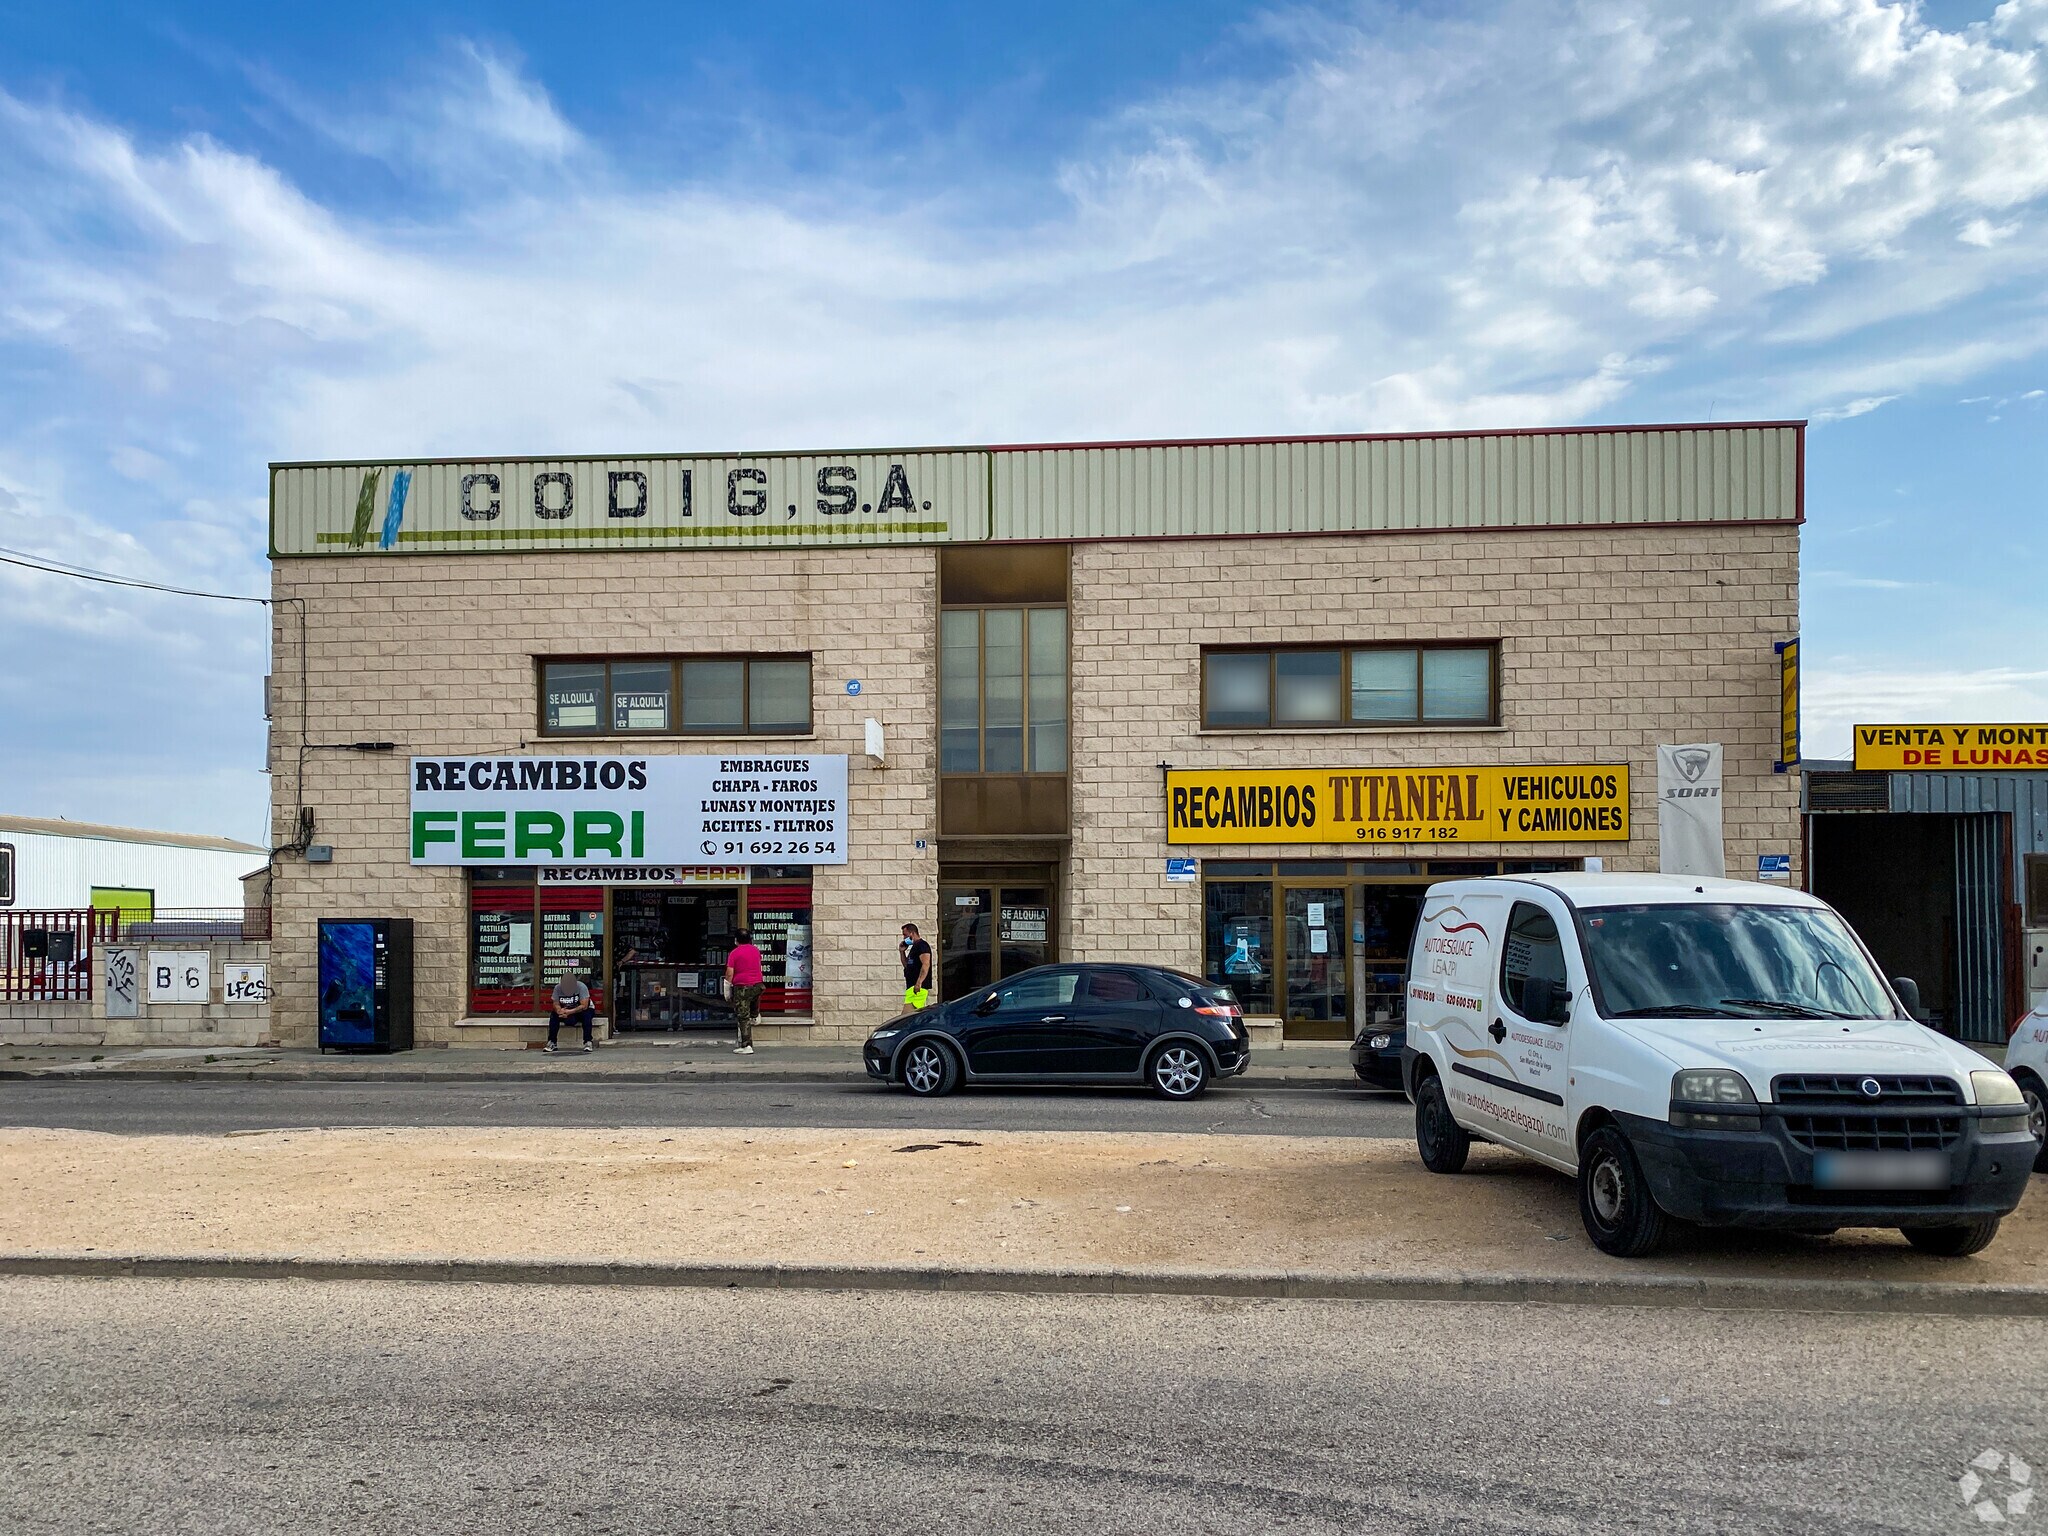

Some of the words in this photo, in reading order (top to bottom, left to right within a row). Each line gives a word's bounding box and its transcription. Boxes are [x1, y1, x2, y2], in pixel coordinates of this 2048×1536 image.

[817, 464, 932, 516] S.A.
[550, 694, 559, 705] SE
[560, 692, 595, 705] ALQUILA
[617, 697, 628, 708] SE
[630, 696, 664, 708] ALQUILA
[1861, 729, 1944, 746] VENTA
[1953, 729, 1969, 745] Y
[1978, 729, 2048, 745] MONT
[1903, 750, 1942, 765] DE
[1953, 749, 2048, 765] LUNAS
[720, 760, 810, 773] EMBRAGUES
[415, 761, 647, 791] RECAMBIOS
[712, 780, 760, 793] CHAPA
[771, 780, 818, 792] FAROS
[1503, 775, 1617, 800] VEHICULOS
[1665, 787, 1720, 799] SORT
[1328, 774, 1485, 822] TITANFAL
[701, 800, 746, 813] LUNAS
[749, 801, 756, 812] Y
[759, 799, 836, 815] MONTAJES
[1173, 785, 1316, 828] RECAMBIOS
[1499, 808, 1512, 832] Y
[1518, 806, 1622, 832] CAMIONES
[702, 820, 762, 833] ACEITES
[773, 819, 834, 832] FILTROS
[413, 811, 645, 858] FERRI
[1356, 828, 1387, 839] 916
[1392, 828, 1422, 839] 917
[1428, 827, 1458, 839] 182
[723, 841, 744, 854] 91
[750, 841, 783, 854] 692
[788, 841, 810, 854] 26
[814, 841, 836, 854] 54
[543, 867, 676, 880] RECAMBIOS
[681, 866, 746, 880] FERRI
[543, 914, 570, 922] BATERIAS
[1001, 909, 1012, 919] SE
[1013, 910, 1046, 920] ALQUILA
[543, 923, 553, 931] KIT
[554, 922, 594, 931] DISTRIBUCIÓN
[753, 922, 778, 930] VOLANTE
[543, 931, 568, 939] BOMBAS
[576, 931, 592, 939] AGUA
[543, 940, 595, 948] AMORTIGUADORES
[543, 949, 566, 957] BRAZOS
[566, 949, 601, 957] SUSPENSIÓN
[479, 966, 522, 974] CATALIZADORES
[572, 967, 592, 975] RUEDA
[157, 966, 172, 989] B
[185, 966, 200, 989] 6
[1448, 1086, 1568, 1142] www.autodesguacelegazpi.com
